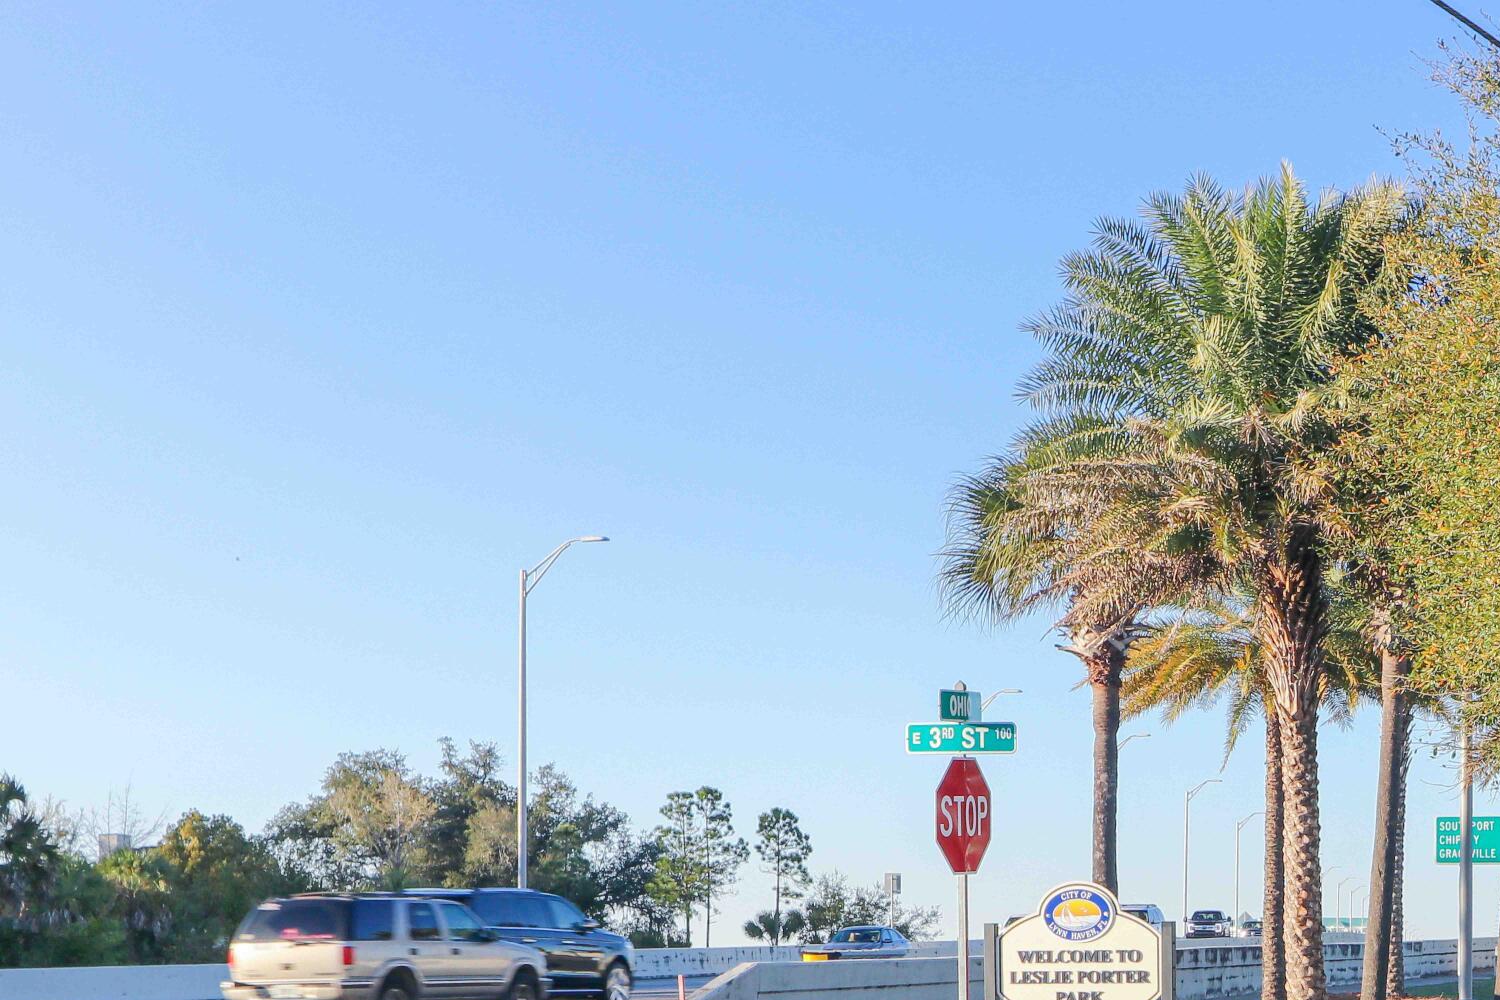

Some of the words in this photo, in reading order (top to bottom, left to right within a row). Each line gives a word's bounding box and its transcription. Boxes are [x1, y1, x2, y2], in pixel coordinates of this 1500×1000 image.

[950, 695, 971, 717] OHIO
[912, 732, 921, 745] E
[929, 727, 954, 749] 3RD
[961, 727, 989, 749] ST
[995, 728, 1012, 740] 100
[940, 795, 988, 838] STOP
[1440, 821, 1495, 831] SOUPORT
[1440, 835, 1480, 845] CHIPY
[1440, 848, 1496, 858] GRAVILLE
[1061, 891, 1079, 901] CITY
[1080, 891, 1093, 900] OF
[1048, 922, 1068, 938] LYNN
[1097, 919, 1108, 931] FL
[1017, 950, 1113, 964] WELCOME
[1115, 950, 1144, 964] TO
[1010, 970, 1074, 985] LESLIE
[1077, 970, 1151, 985] PORTER
